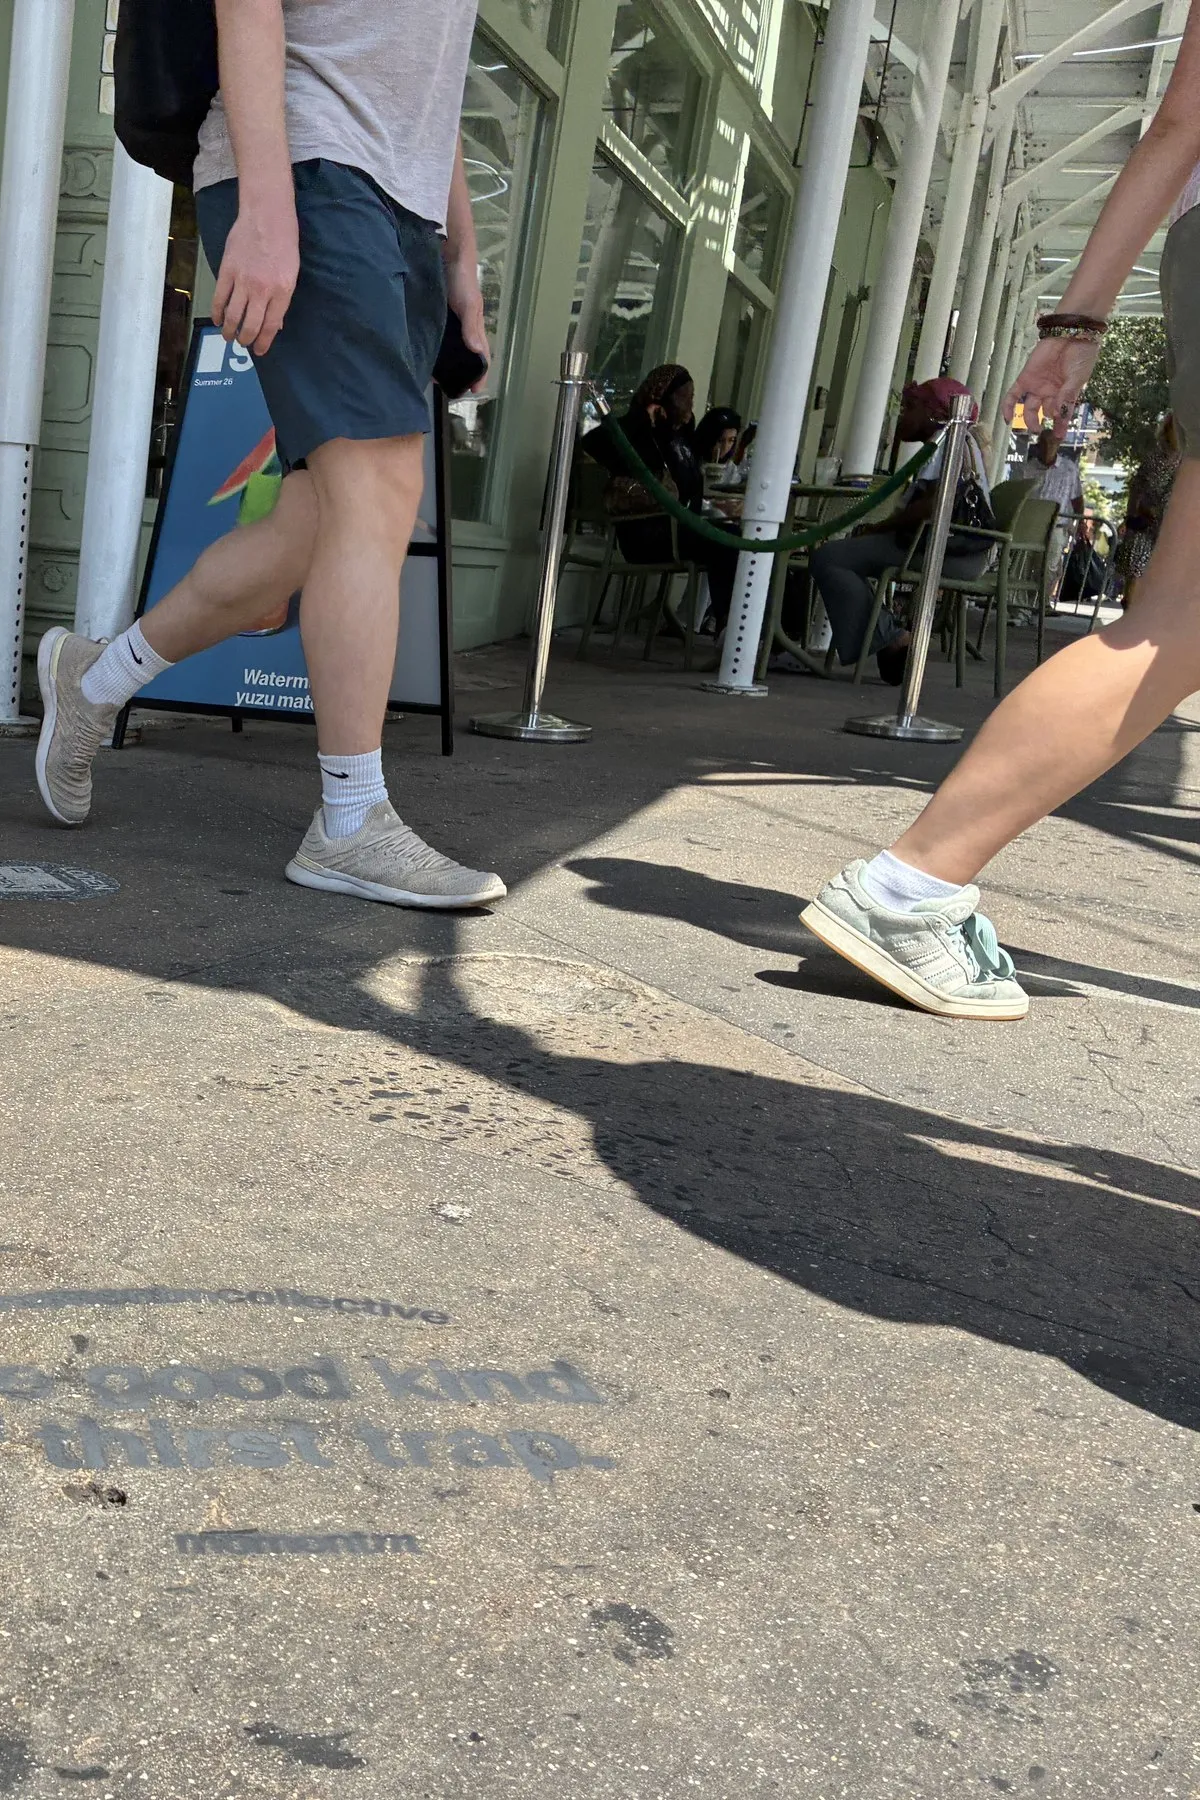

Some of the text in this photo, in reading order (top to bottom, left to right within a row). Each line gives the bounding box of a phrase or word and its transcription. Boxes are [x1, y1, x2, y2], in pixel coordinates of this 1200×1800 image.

[1005, 451, 1024, 463] nix
[244, 668, 311, 689] Waterm
[234, 691, 275, 707] yuzu
[214, 1288, 450, 1325] collective
[84, 1356, 352, 1409] good
[371, 1357, 602, 1402] kind
